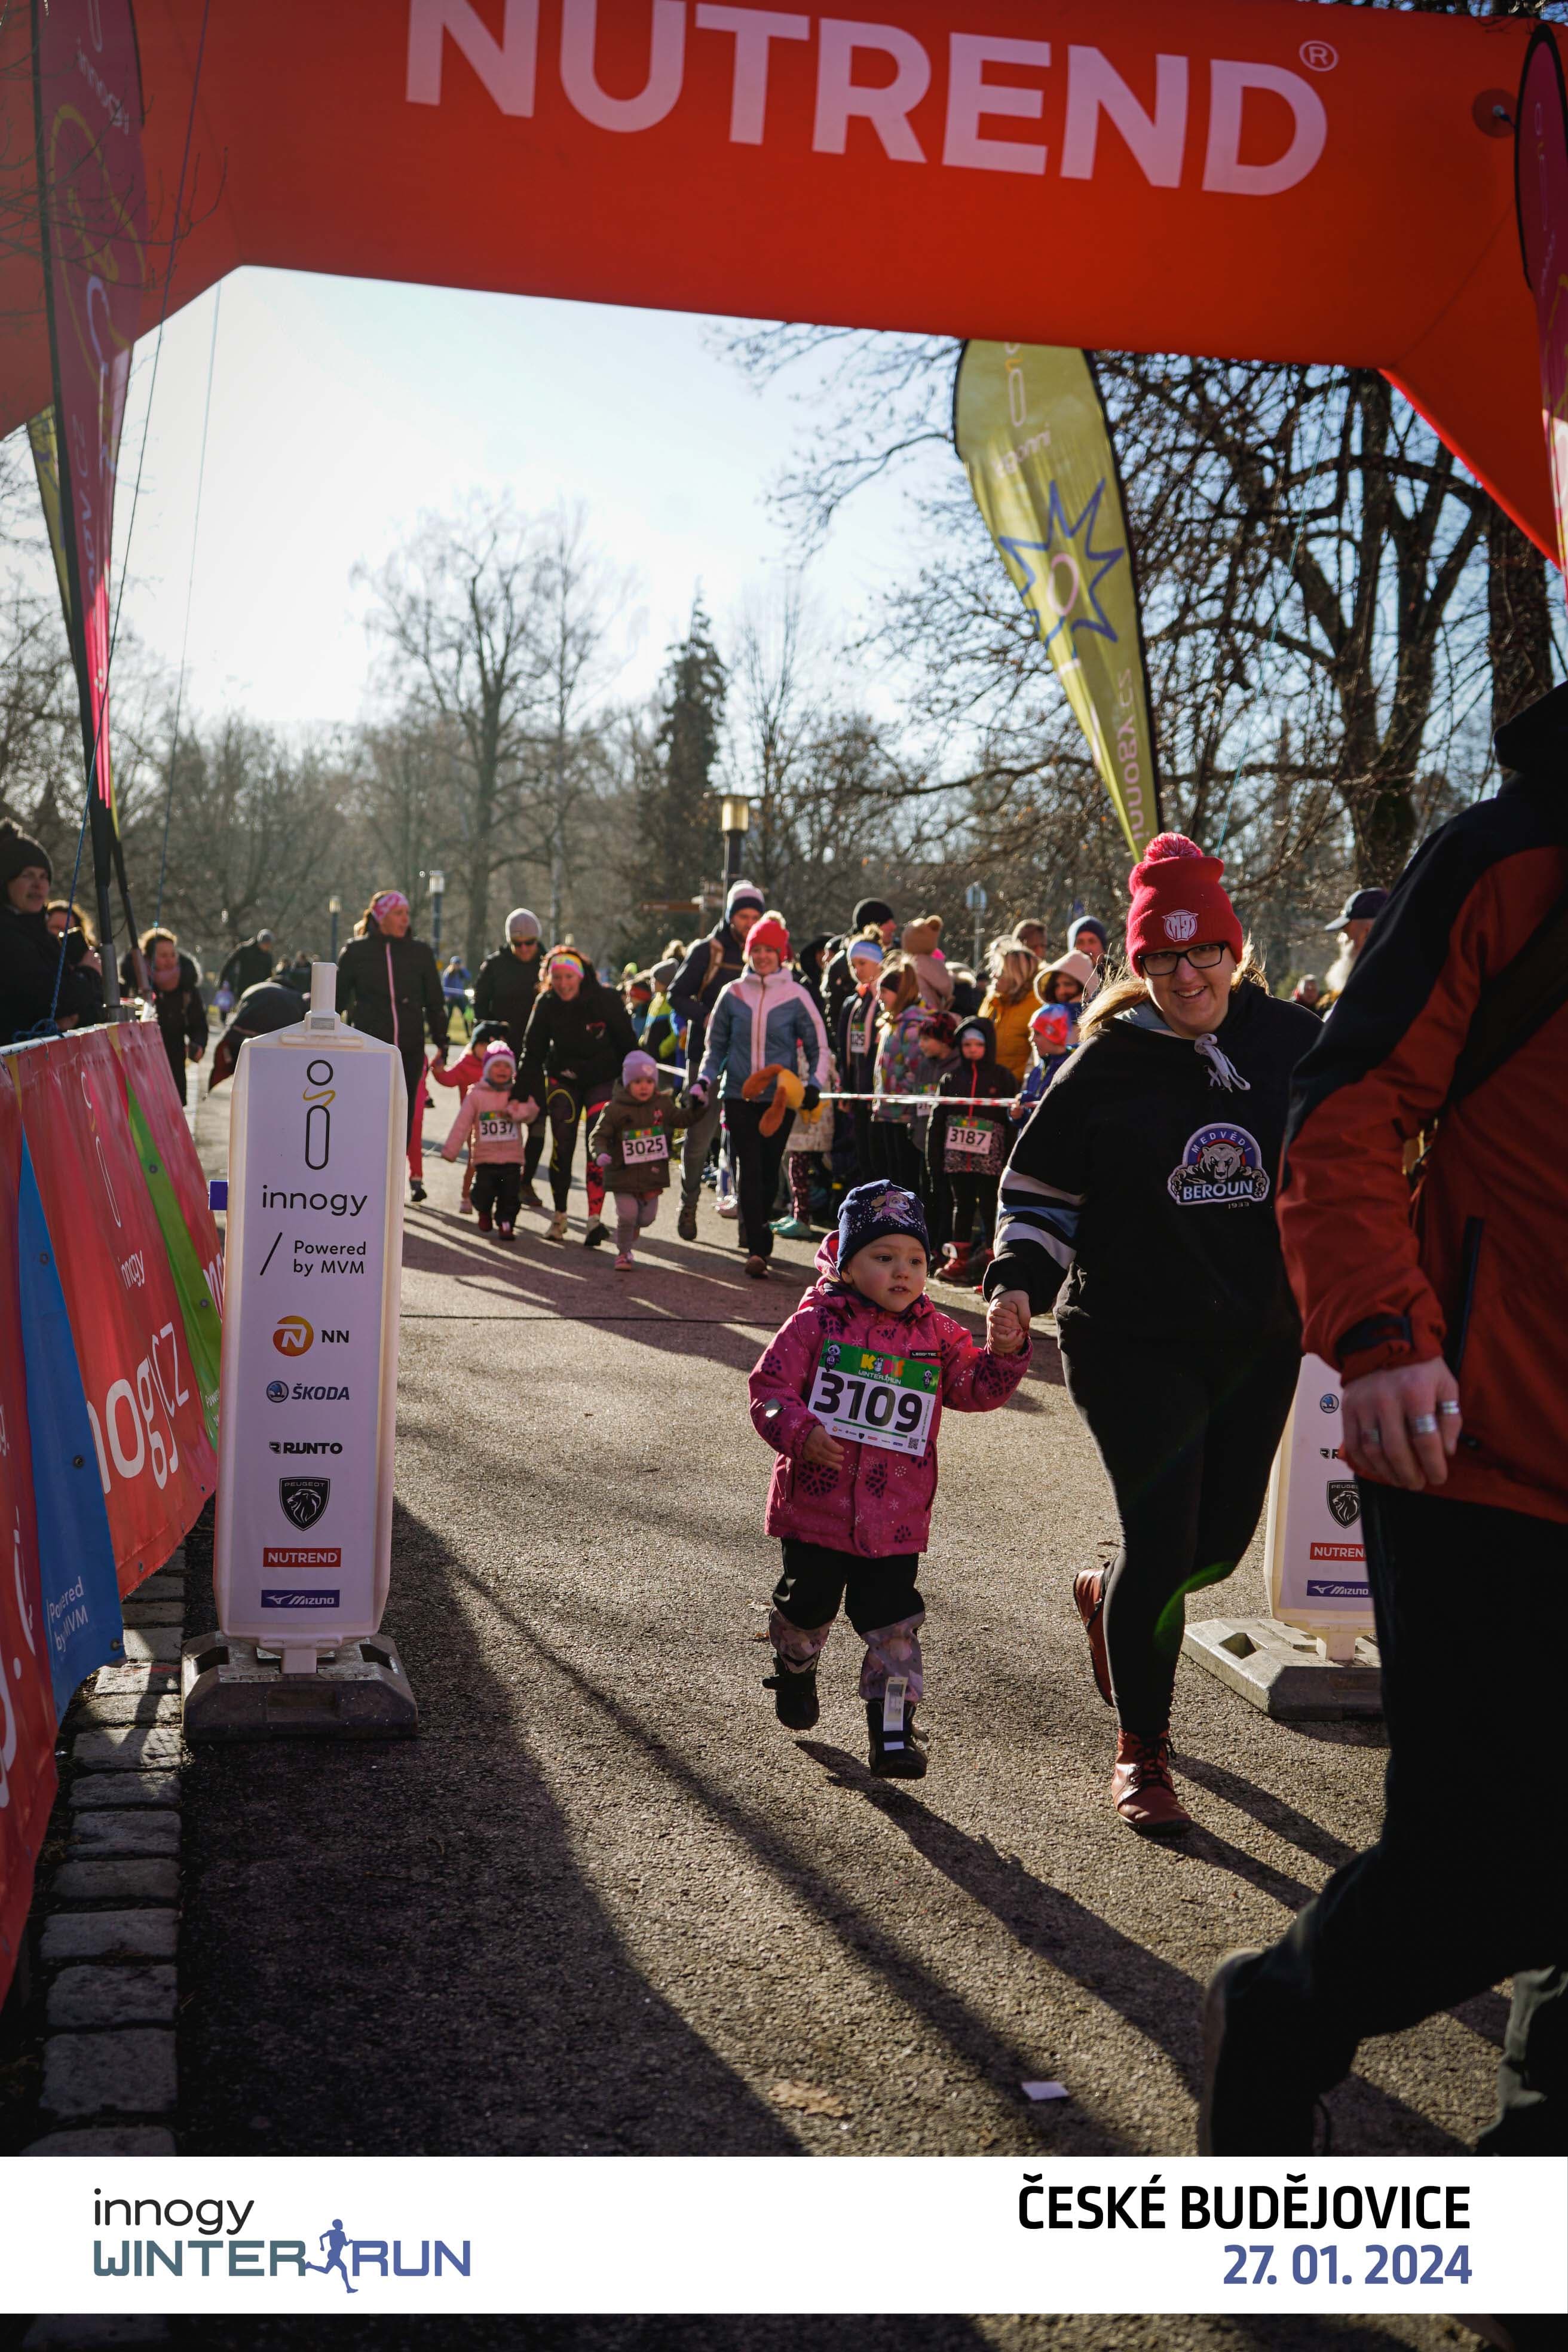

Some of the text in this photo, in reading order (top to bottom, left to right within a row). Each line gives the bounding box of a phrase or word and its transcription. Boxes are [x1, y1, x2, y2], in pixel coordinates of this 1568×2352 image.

[405, 0, 1328, 196] NUTREND
[481, 1120, 514, 1135] 3037
[950, 1128, 987, 1146] 3187
[624, 1138, 663, 1156] 3025
[1183, 1180, 1253, 1200] BEROUN
[262, 1184, 368, 1217] innogy
[294, 1240, 366, 1255] Powered
[293, 1258, 364, 1277] by MVM
[321, 1330, 350, 1343] NN
[291, 1383, 350, 1400] ŠKODA
[813, 1372, 923, 1433] 3109
[283, 1442, 343, 1454] RUNTO
[268, 1552, 338, 1563] NUTREND
[1314, 1546, 1365, 1558] NUTREN
